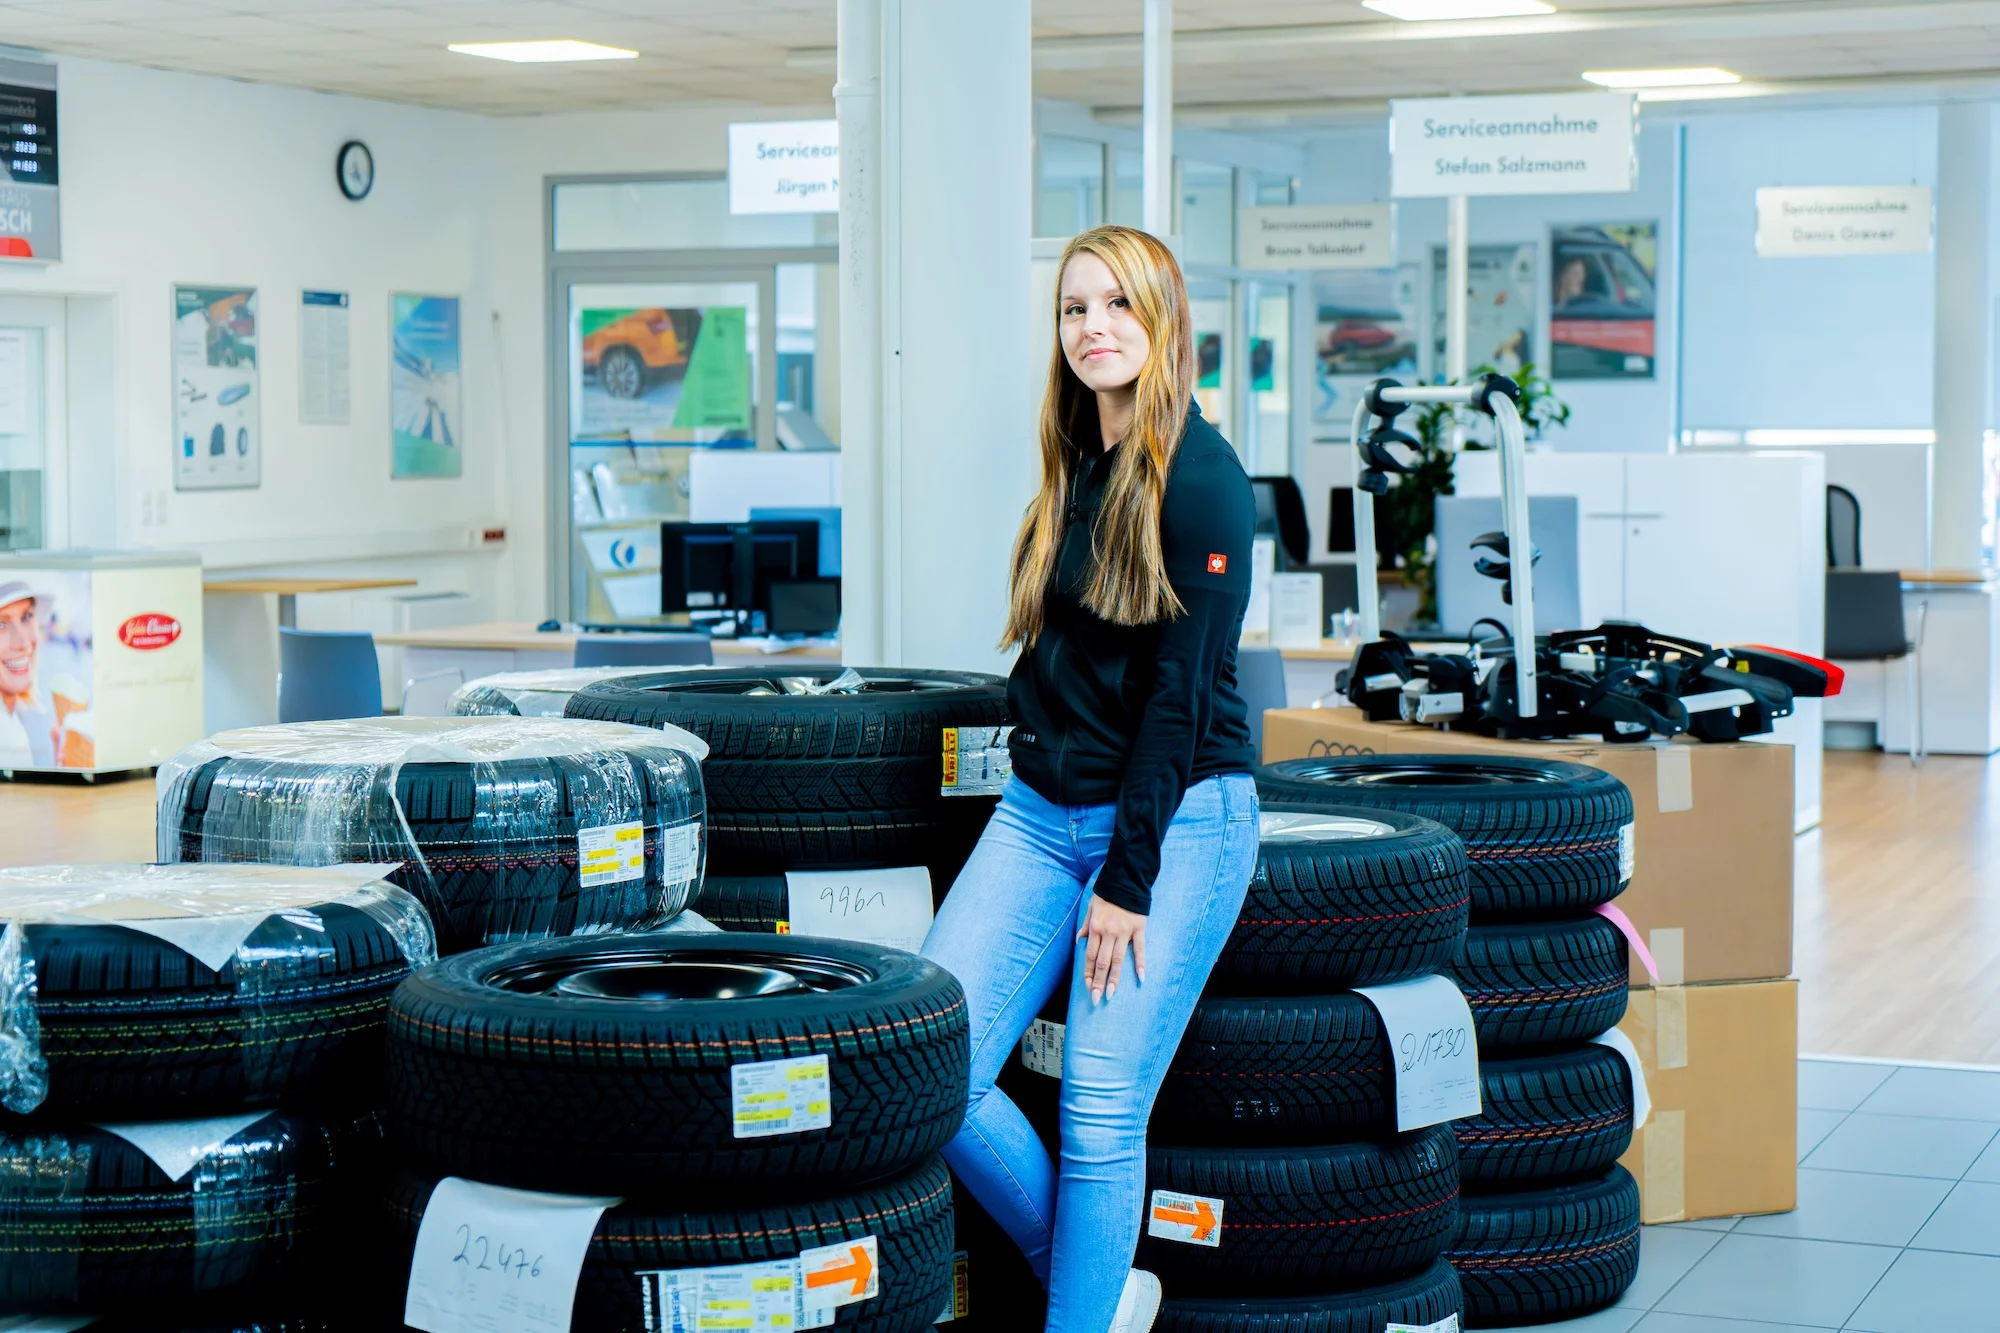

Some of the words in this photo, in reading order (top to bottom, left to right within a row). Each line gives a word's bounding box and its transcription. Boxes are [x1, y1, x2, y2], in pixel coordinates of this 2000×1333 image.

[1423, 114, 1598, 139] Serviceannahme
[1435, 156, 1491, 176] Stefan
[1497, 154, 1586, 174] Salzmann
[775, 178, 826, 197] Jürgen
[1401, 1028, 1466, 1073] 21730
[453, 1223, 544, 1279] 22476
[641, 1276, 653, 1329] DUNLOP
